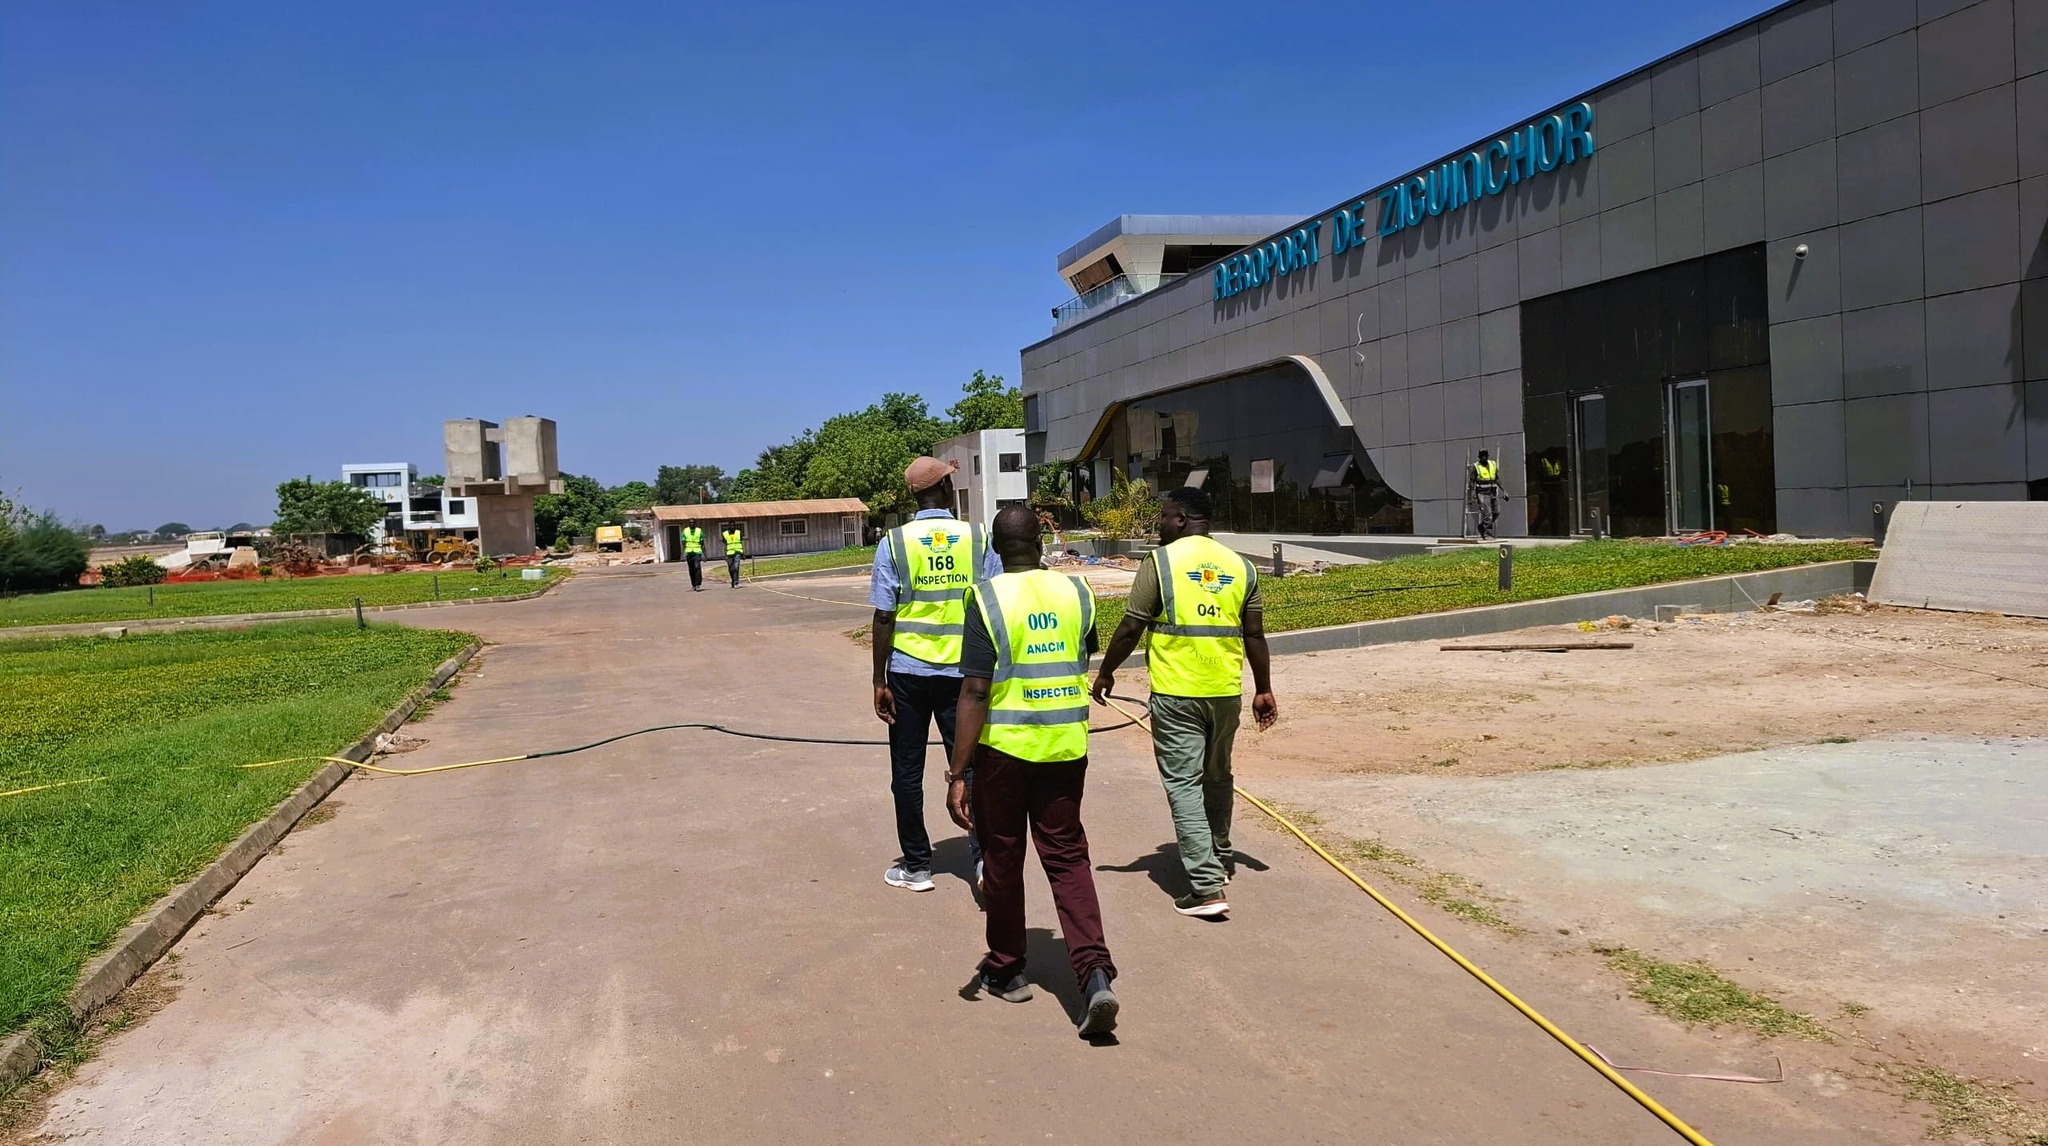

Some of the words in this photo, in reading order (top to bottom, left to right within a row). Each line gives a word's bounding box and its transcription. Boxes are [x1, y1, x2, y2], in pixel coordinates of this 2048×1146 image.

[1213, 220, 1323, 301] AEROPORT
[1332, 201, 1367, 255] DE
[1377, 102, 1594, 238] ZIGUINCHOR
[928, 555, 955, 571] 168
[915, 574, 968, 585] INSPECTION
[1028, 612, 1058, 631] 006
